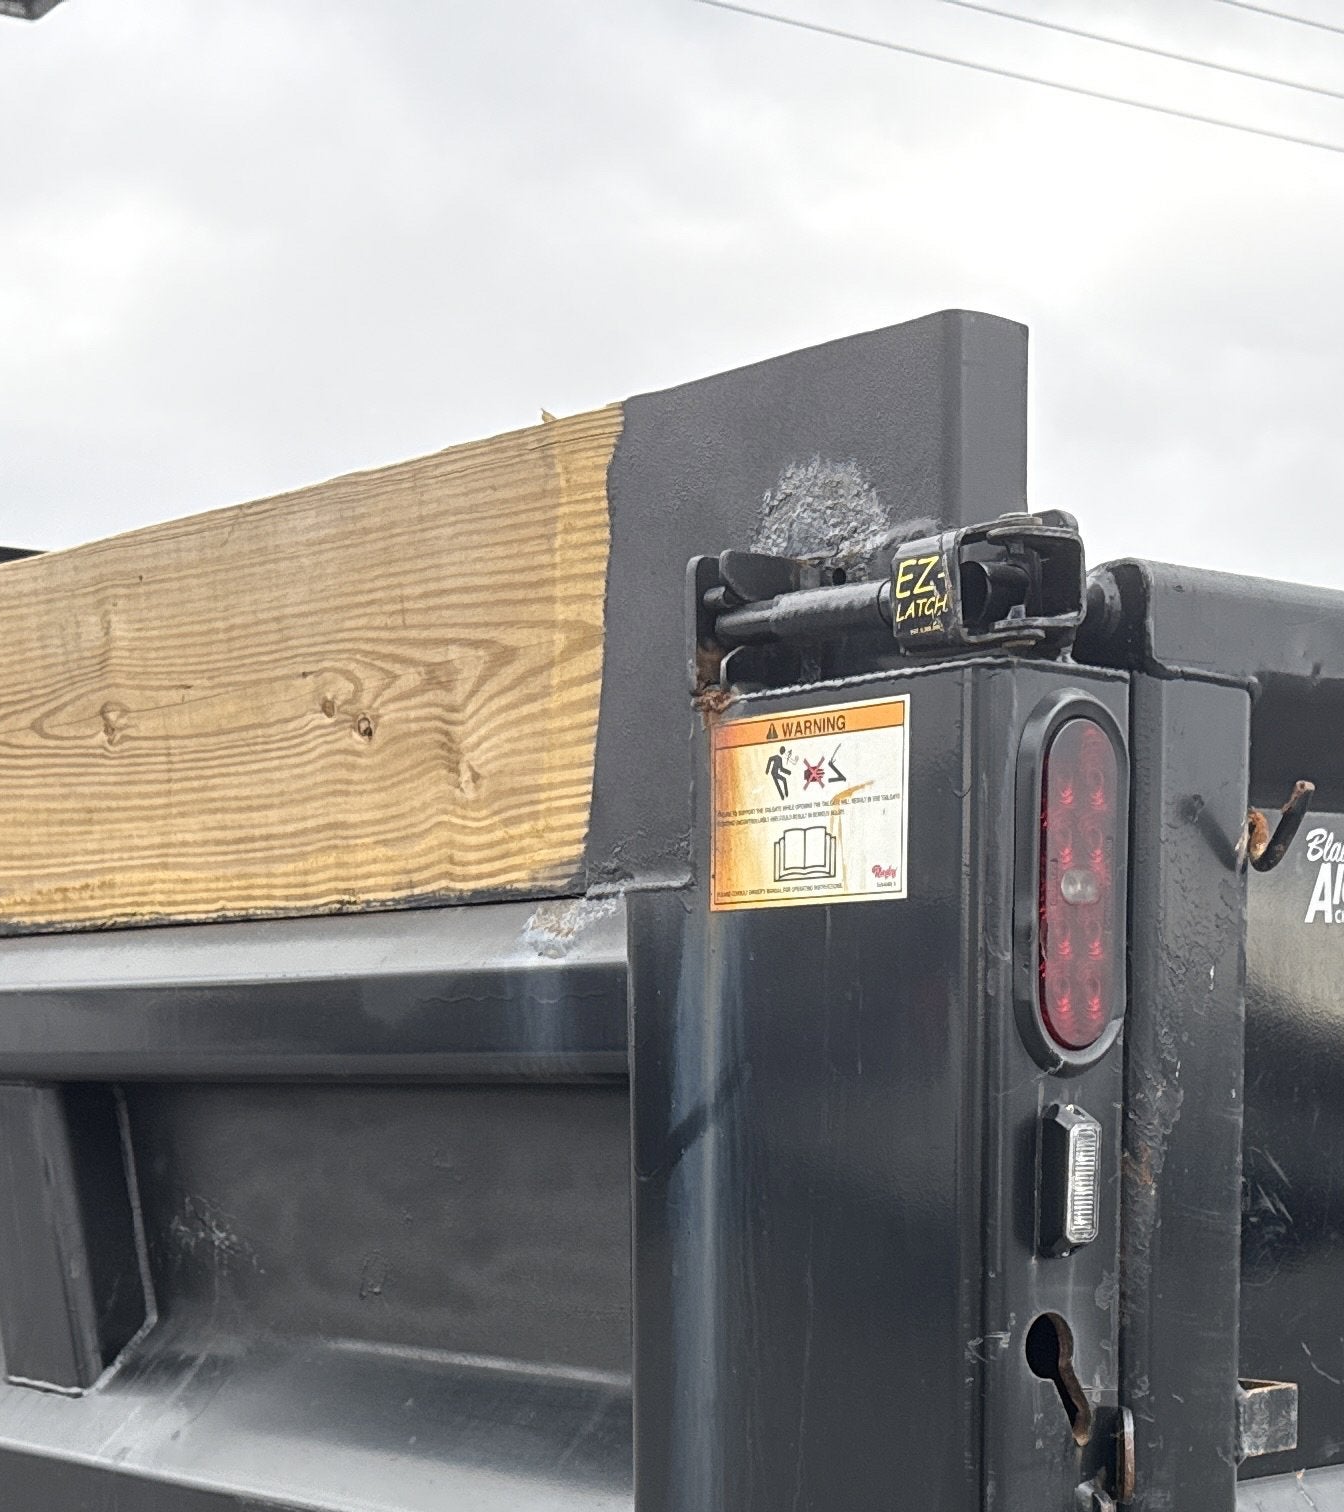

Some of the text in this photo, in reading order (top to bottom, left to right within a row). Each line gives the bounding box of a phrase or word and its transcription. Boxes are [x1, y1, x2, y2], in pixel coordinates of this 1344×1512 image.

[896, 555, 946, 599] EZ-
[896, 593, 949, 623] LATCH
[781, 714, 847, 738] WARNING
